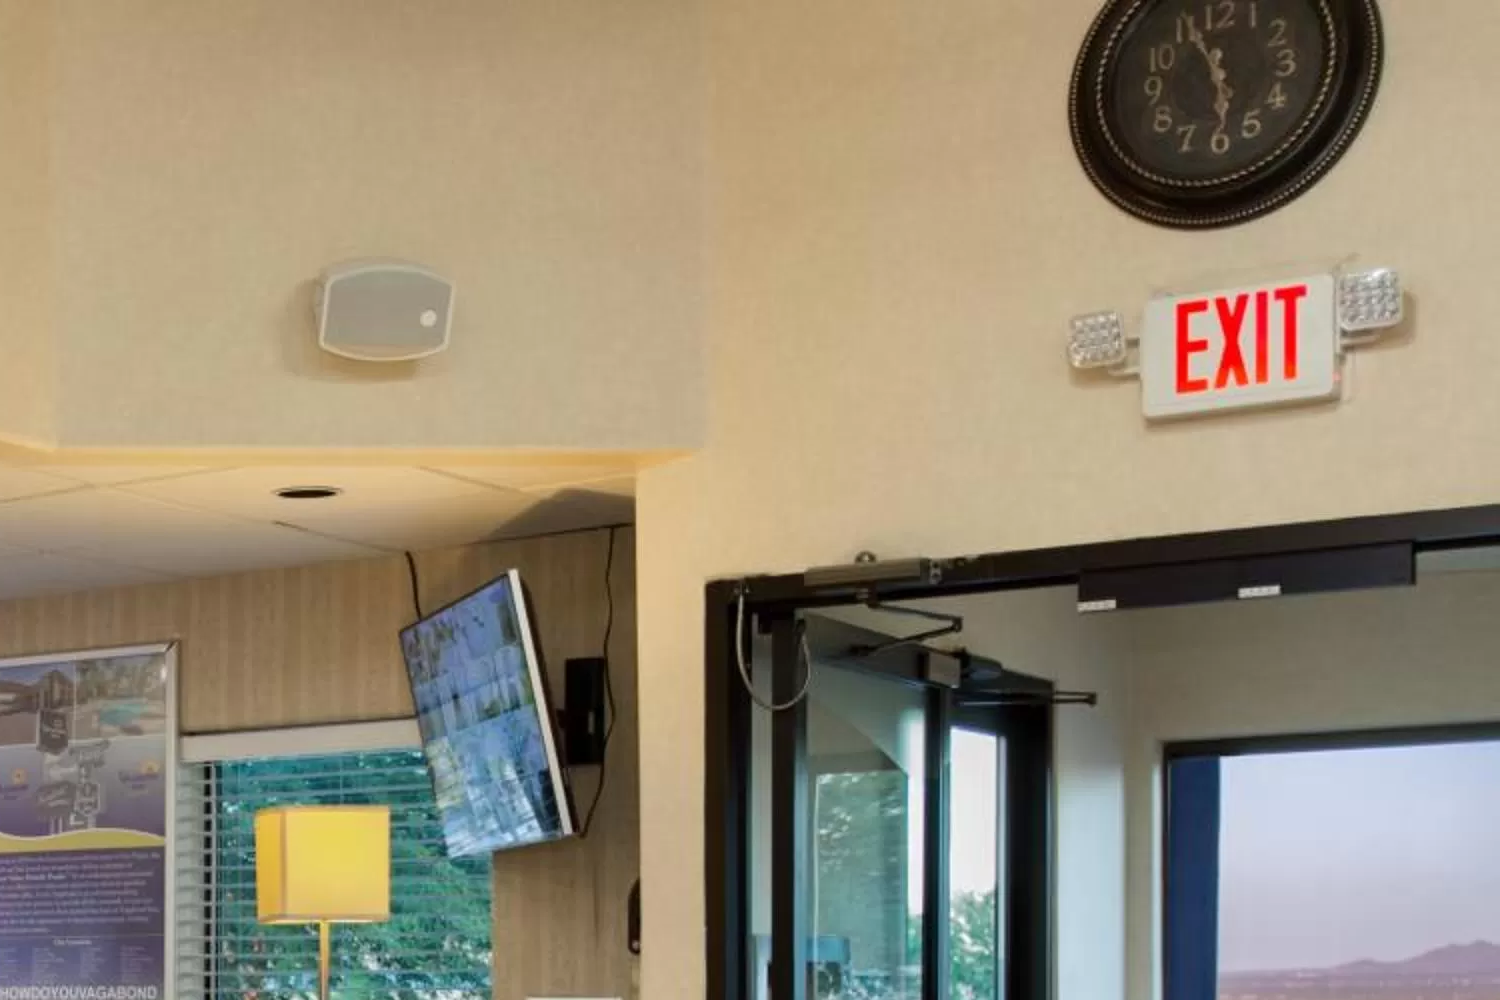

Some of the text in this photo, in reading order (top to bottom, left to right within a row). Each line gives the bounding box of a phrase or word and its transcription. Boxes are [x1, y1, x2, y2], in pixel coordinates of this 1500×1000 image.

[1205, 1, 1236, 31] 12
[1250, 2, 1257, 29] 1
[1267, 19, 1288, 47] 2
[1149, 43, 1175, 73] 10
[1274, 49, 1298, 78] 3
[1143, 75, 1163, 106] 9
[1265, 82, 1288, 110] 4
[1153, 105, 1173, 134] 8
[1241, 108, 1262, 139] 5
[1176, 123, 1198, 153] 7
[1175, 284, 1307, 395] EXIT
